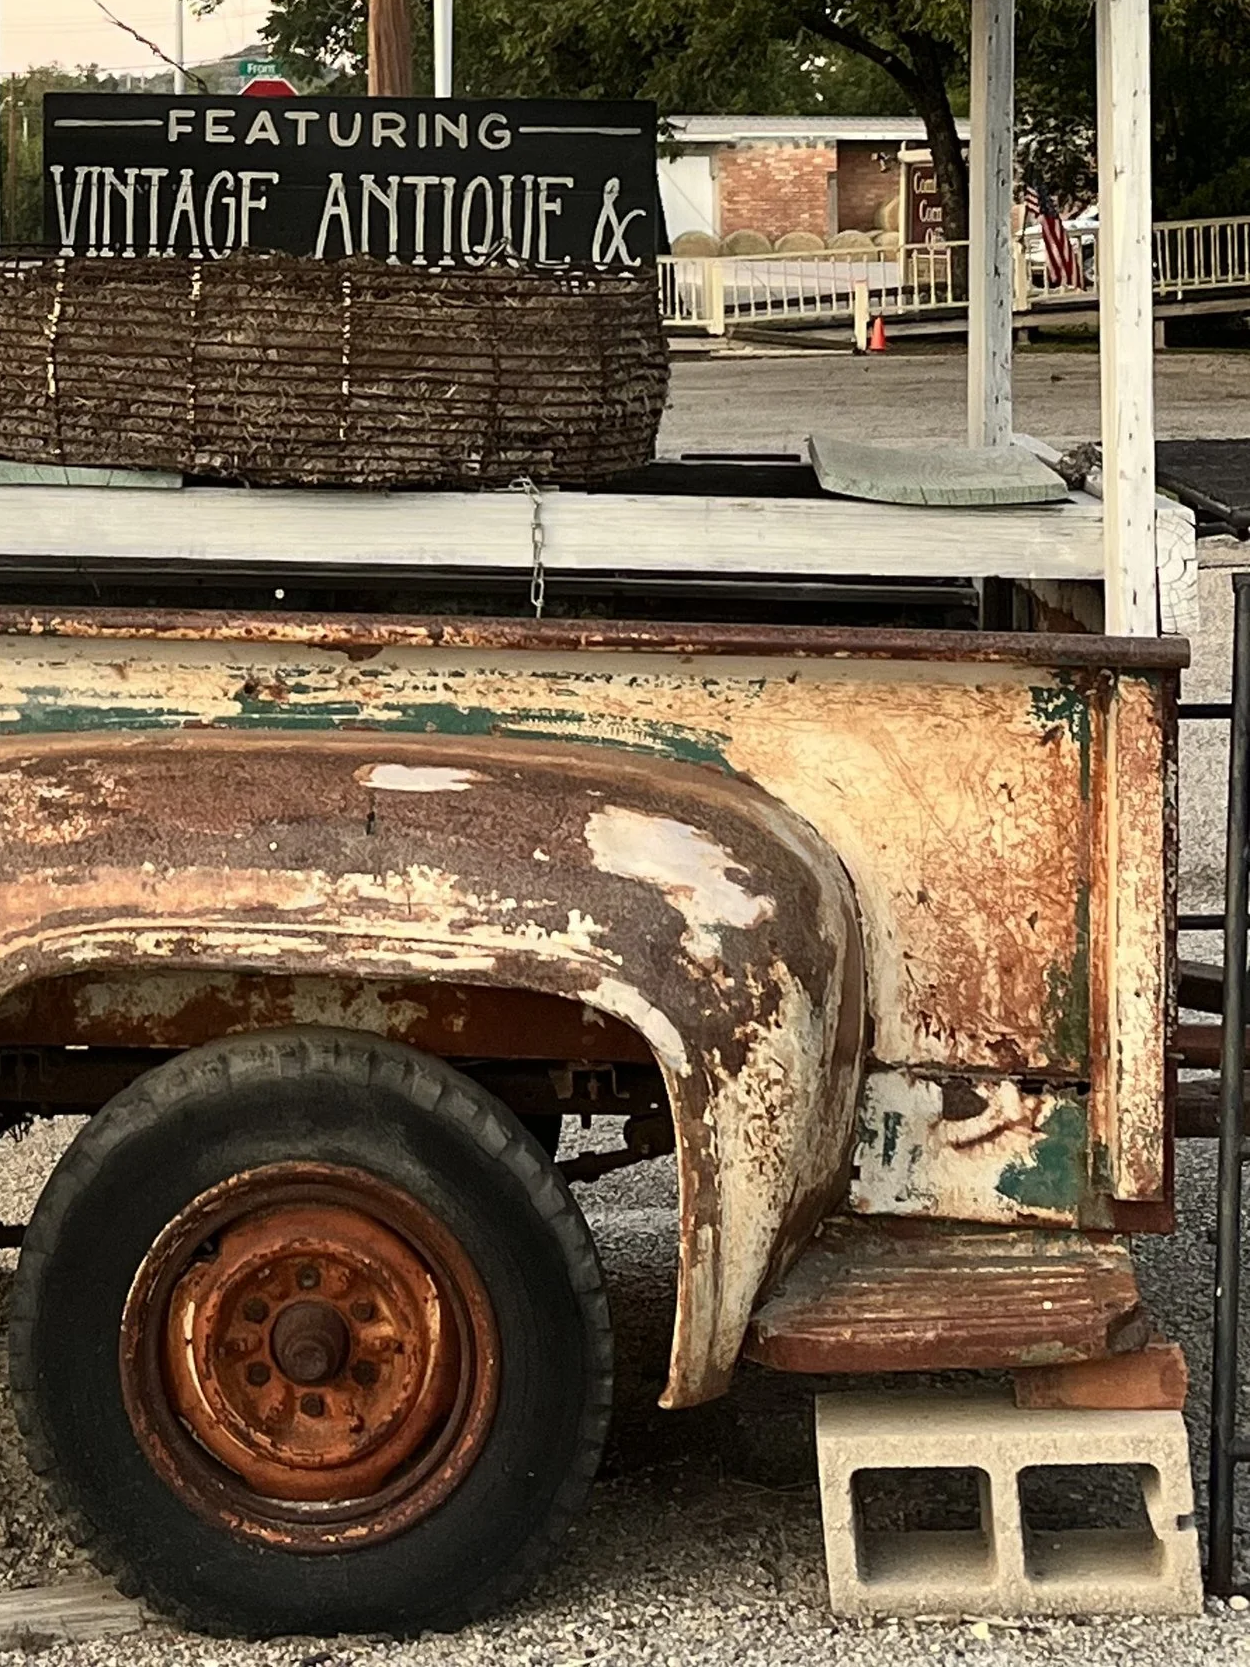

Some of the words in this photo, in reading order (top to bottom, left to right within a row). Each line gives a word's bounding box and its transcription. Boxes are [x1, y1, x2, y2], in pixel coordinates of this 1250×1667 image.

[166, 108, 513, 151] FEATURING
[50, 164, 280, 260] VINTAGE
[312, 172, 575, 269] ANTIQUE
[591, 176, 647, 270] &
